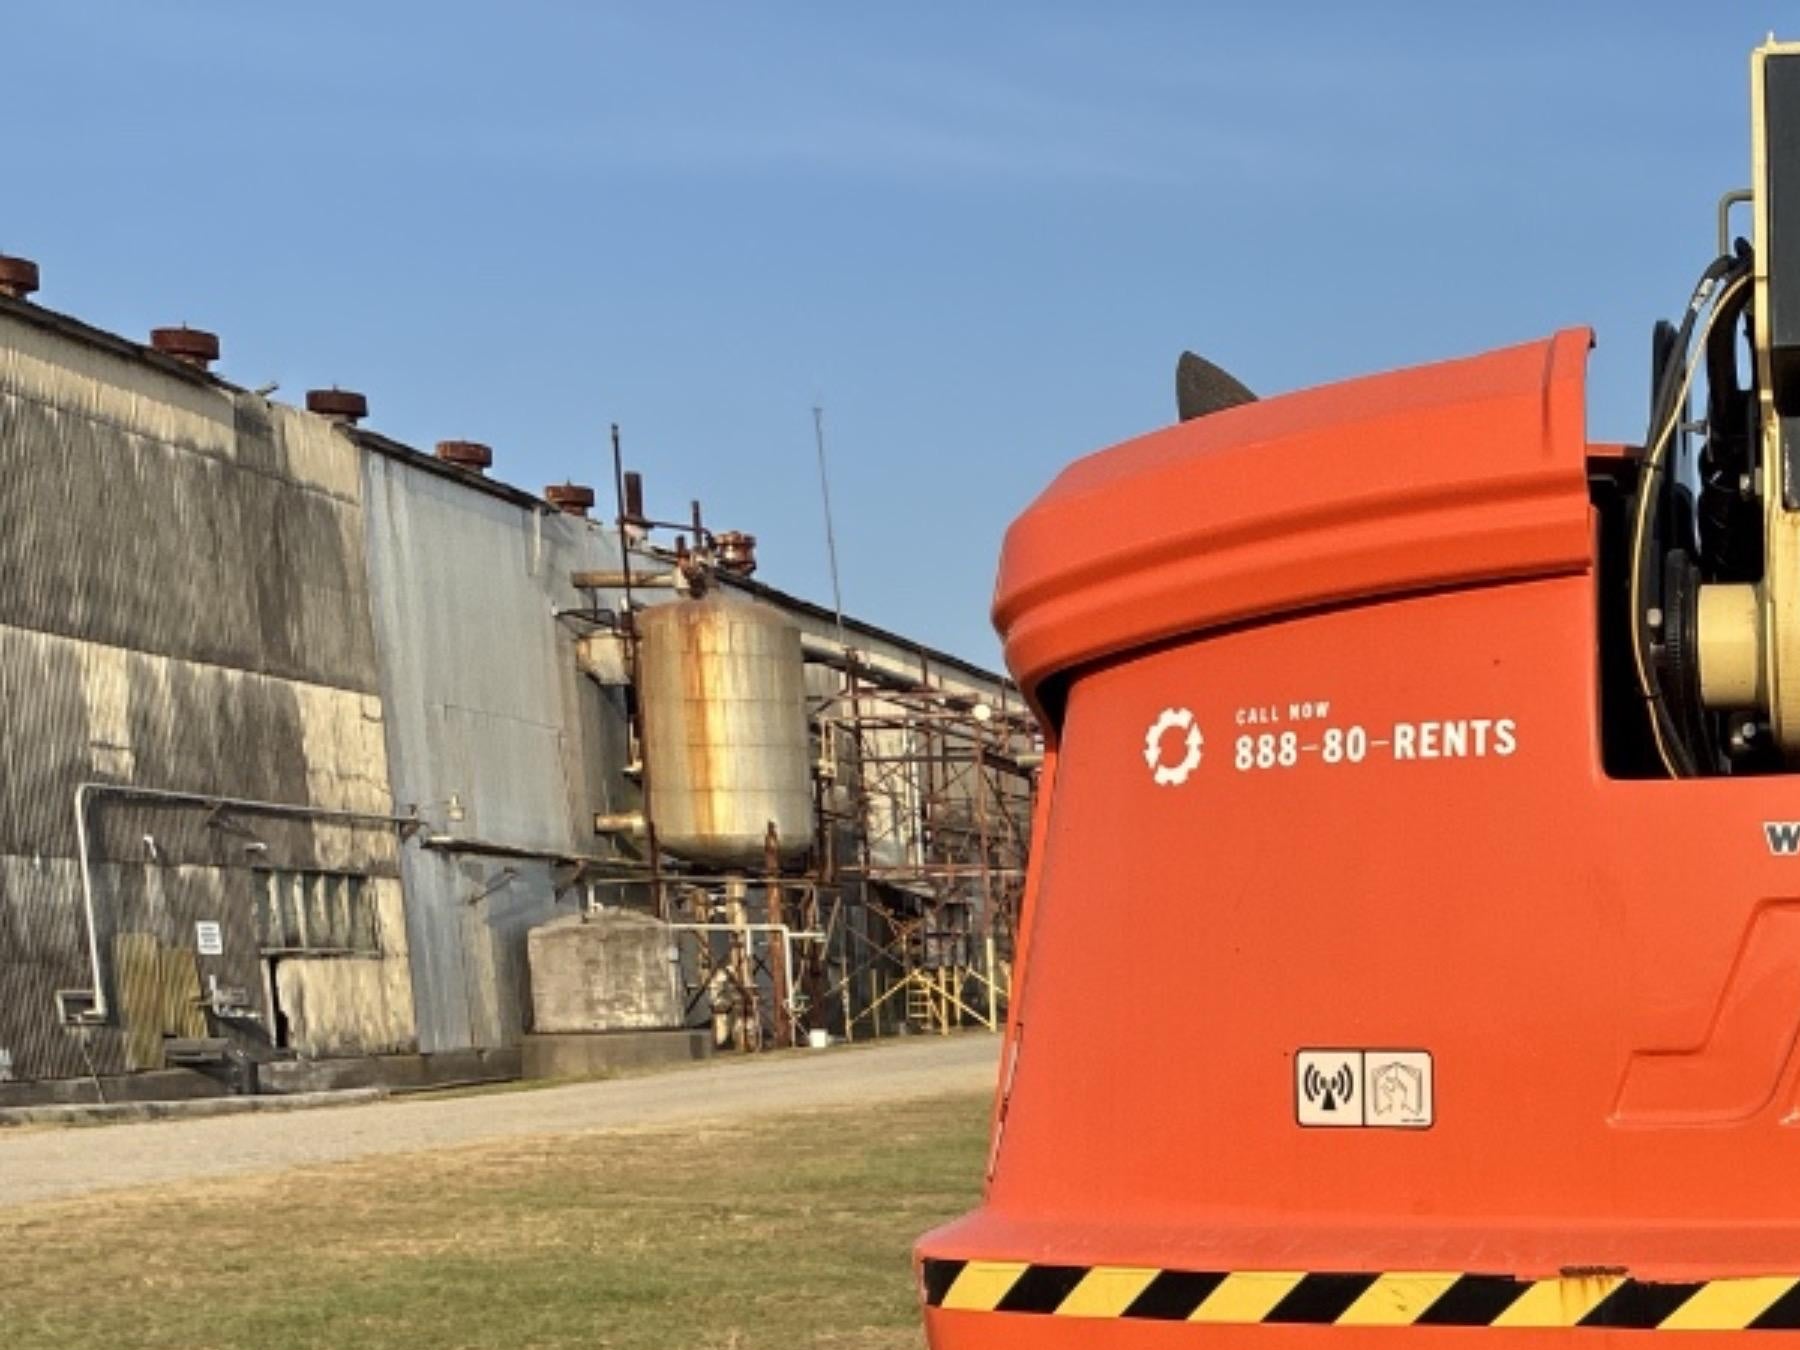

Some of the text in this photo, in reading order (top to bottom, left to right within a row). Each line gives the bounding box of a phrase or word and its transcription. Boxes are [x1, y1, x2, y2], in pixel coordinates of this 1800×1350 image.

[1235, 701, 1330, 726] CALL NOW
[1234, 718, 1517, 771] 888-80-RENTS
